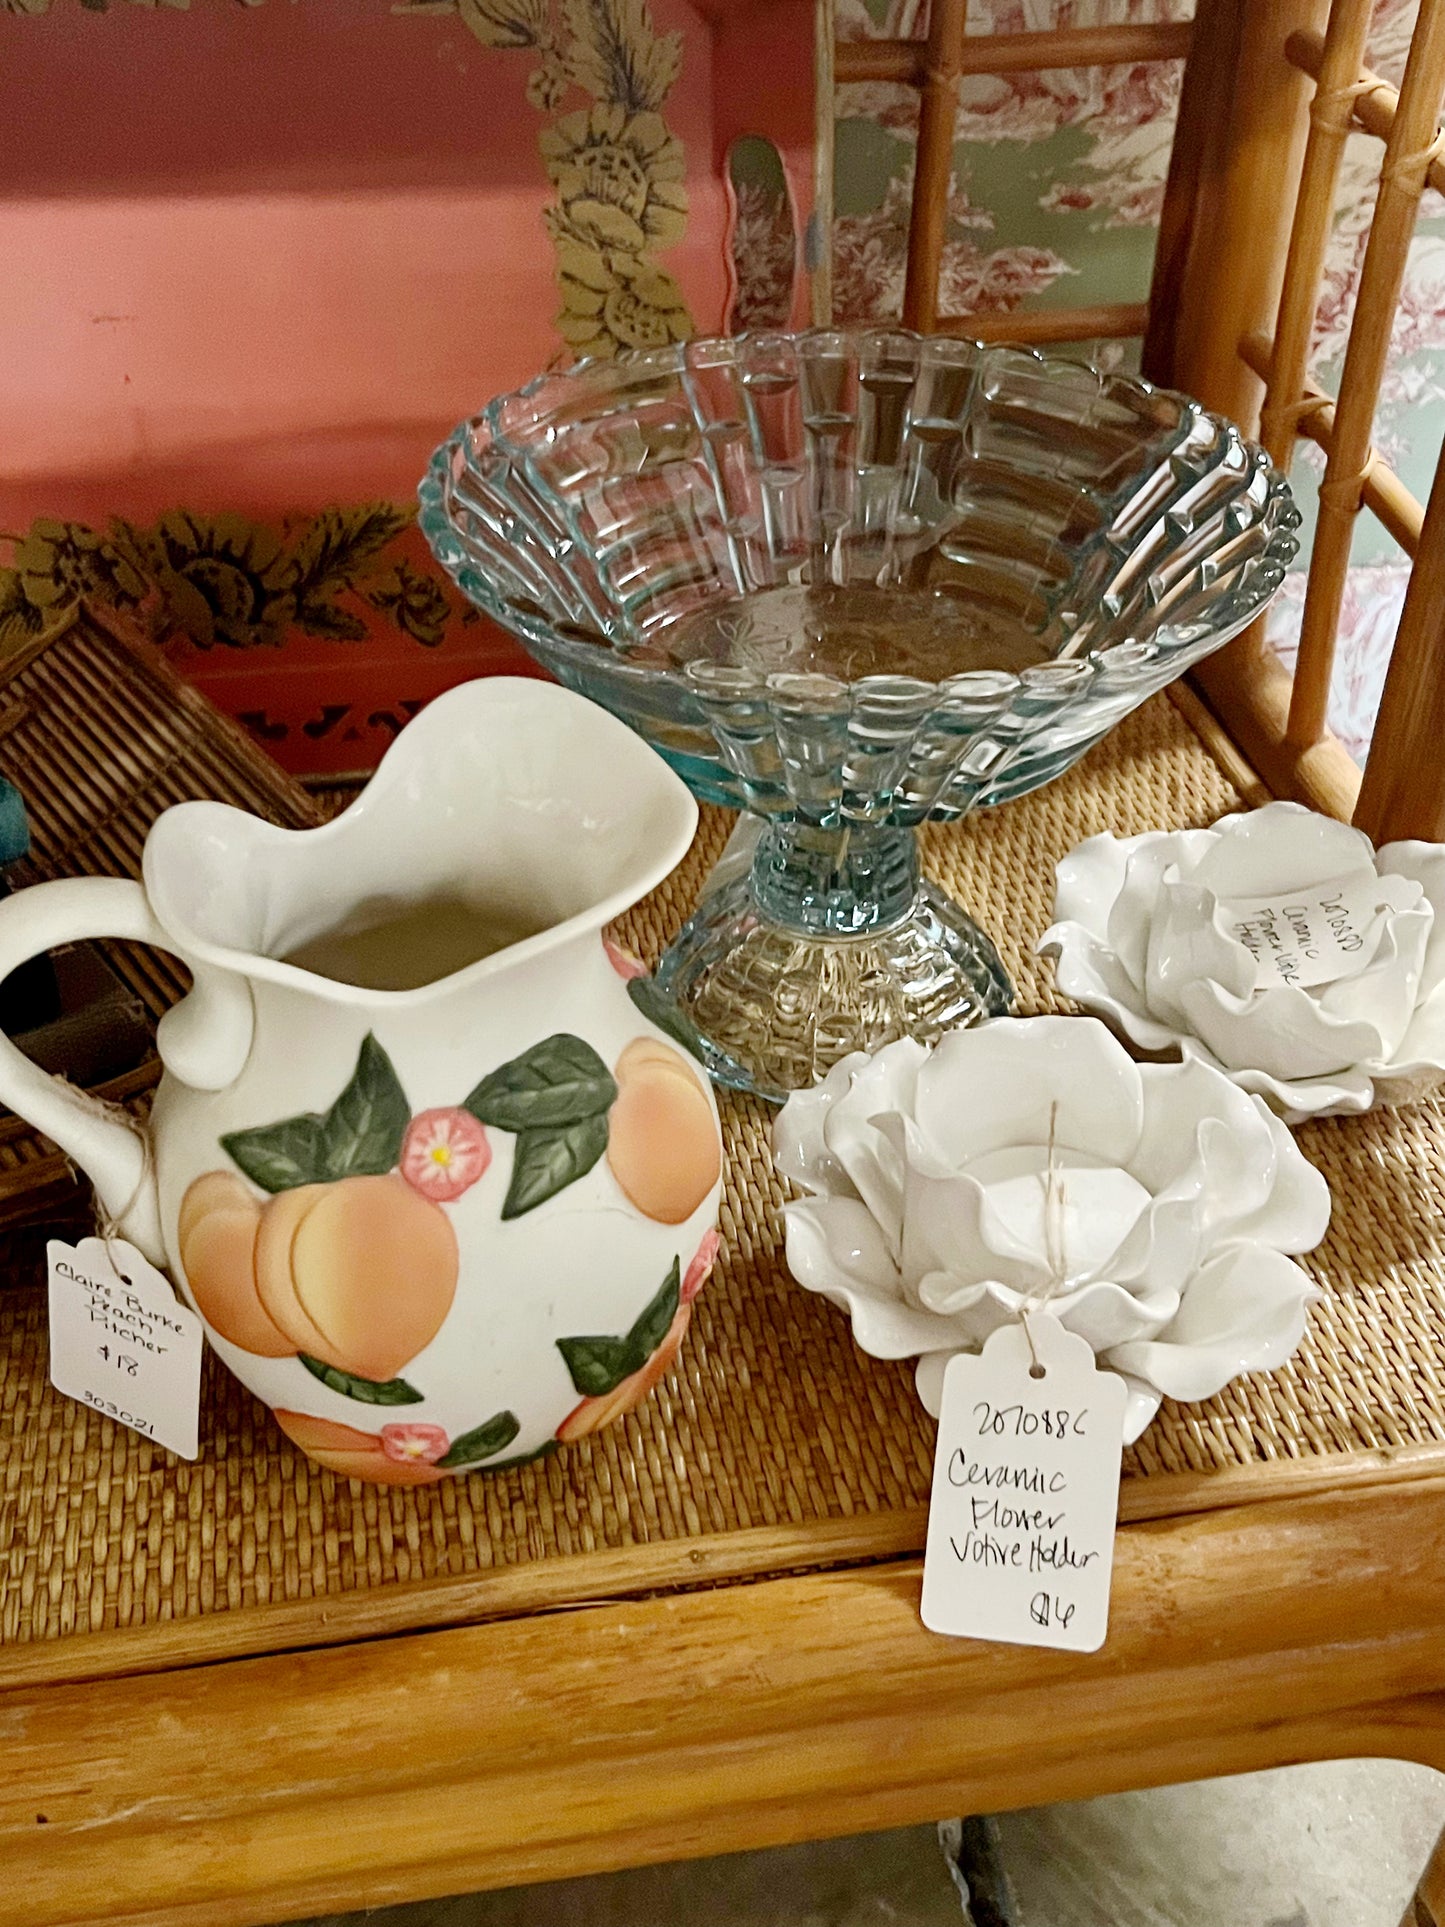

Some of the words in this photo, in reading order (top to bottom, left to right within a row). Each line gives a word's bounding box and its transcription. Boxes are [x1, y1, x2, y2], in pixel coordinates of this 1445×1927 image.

[55, 1262, 112, 1298] Claire
[120, 1290, 185, 1336] Burke
[85, 1289, 153, 1335] Peach
[84, 1304, 169, 1354] Pitcher
[948, 1448, 1067, 1494] Ceramic
[971, 1496, 1066, 1531] Flower
[950, 1531, 1022, 1567] Votive
[1029, 1535, 1099, 1572] Holder
